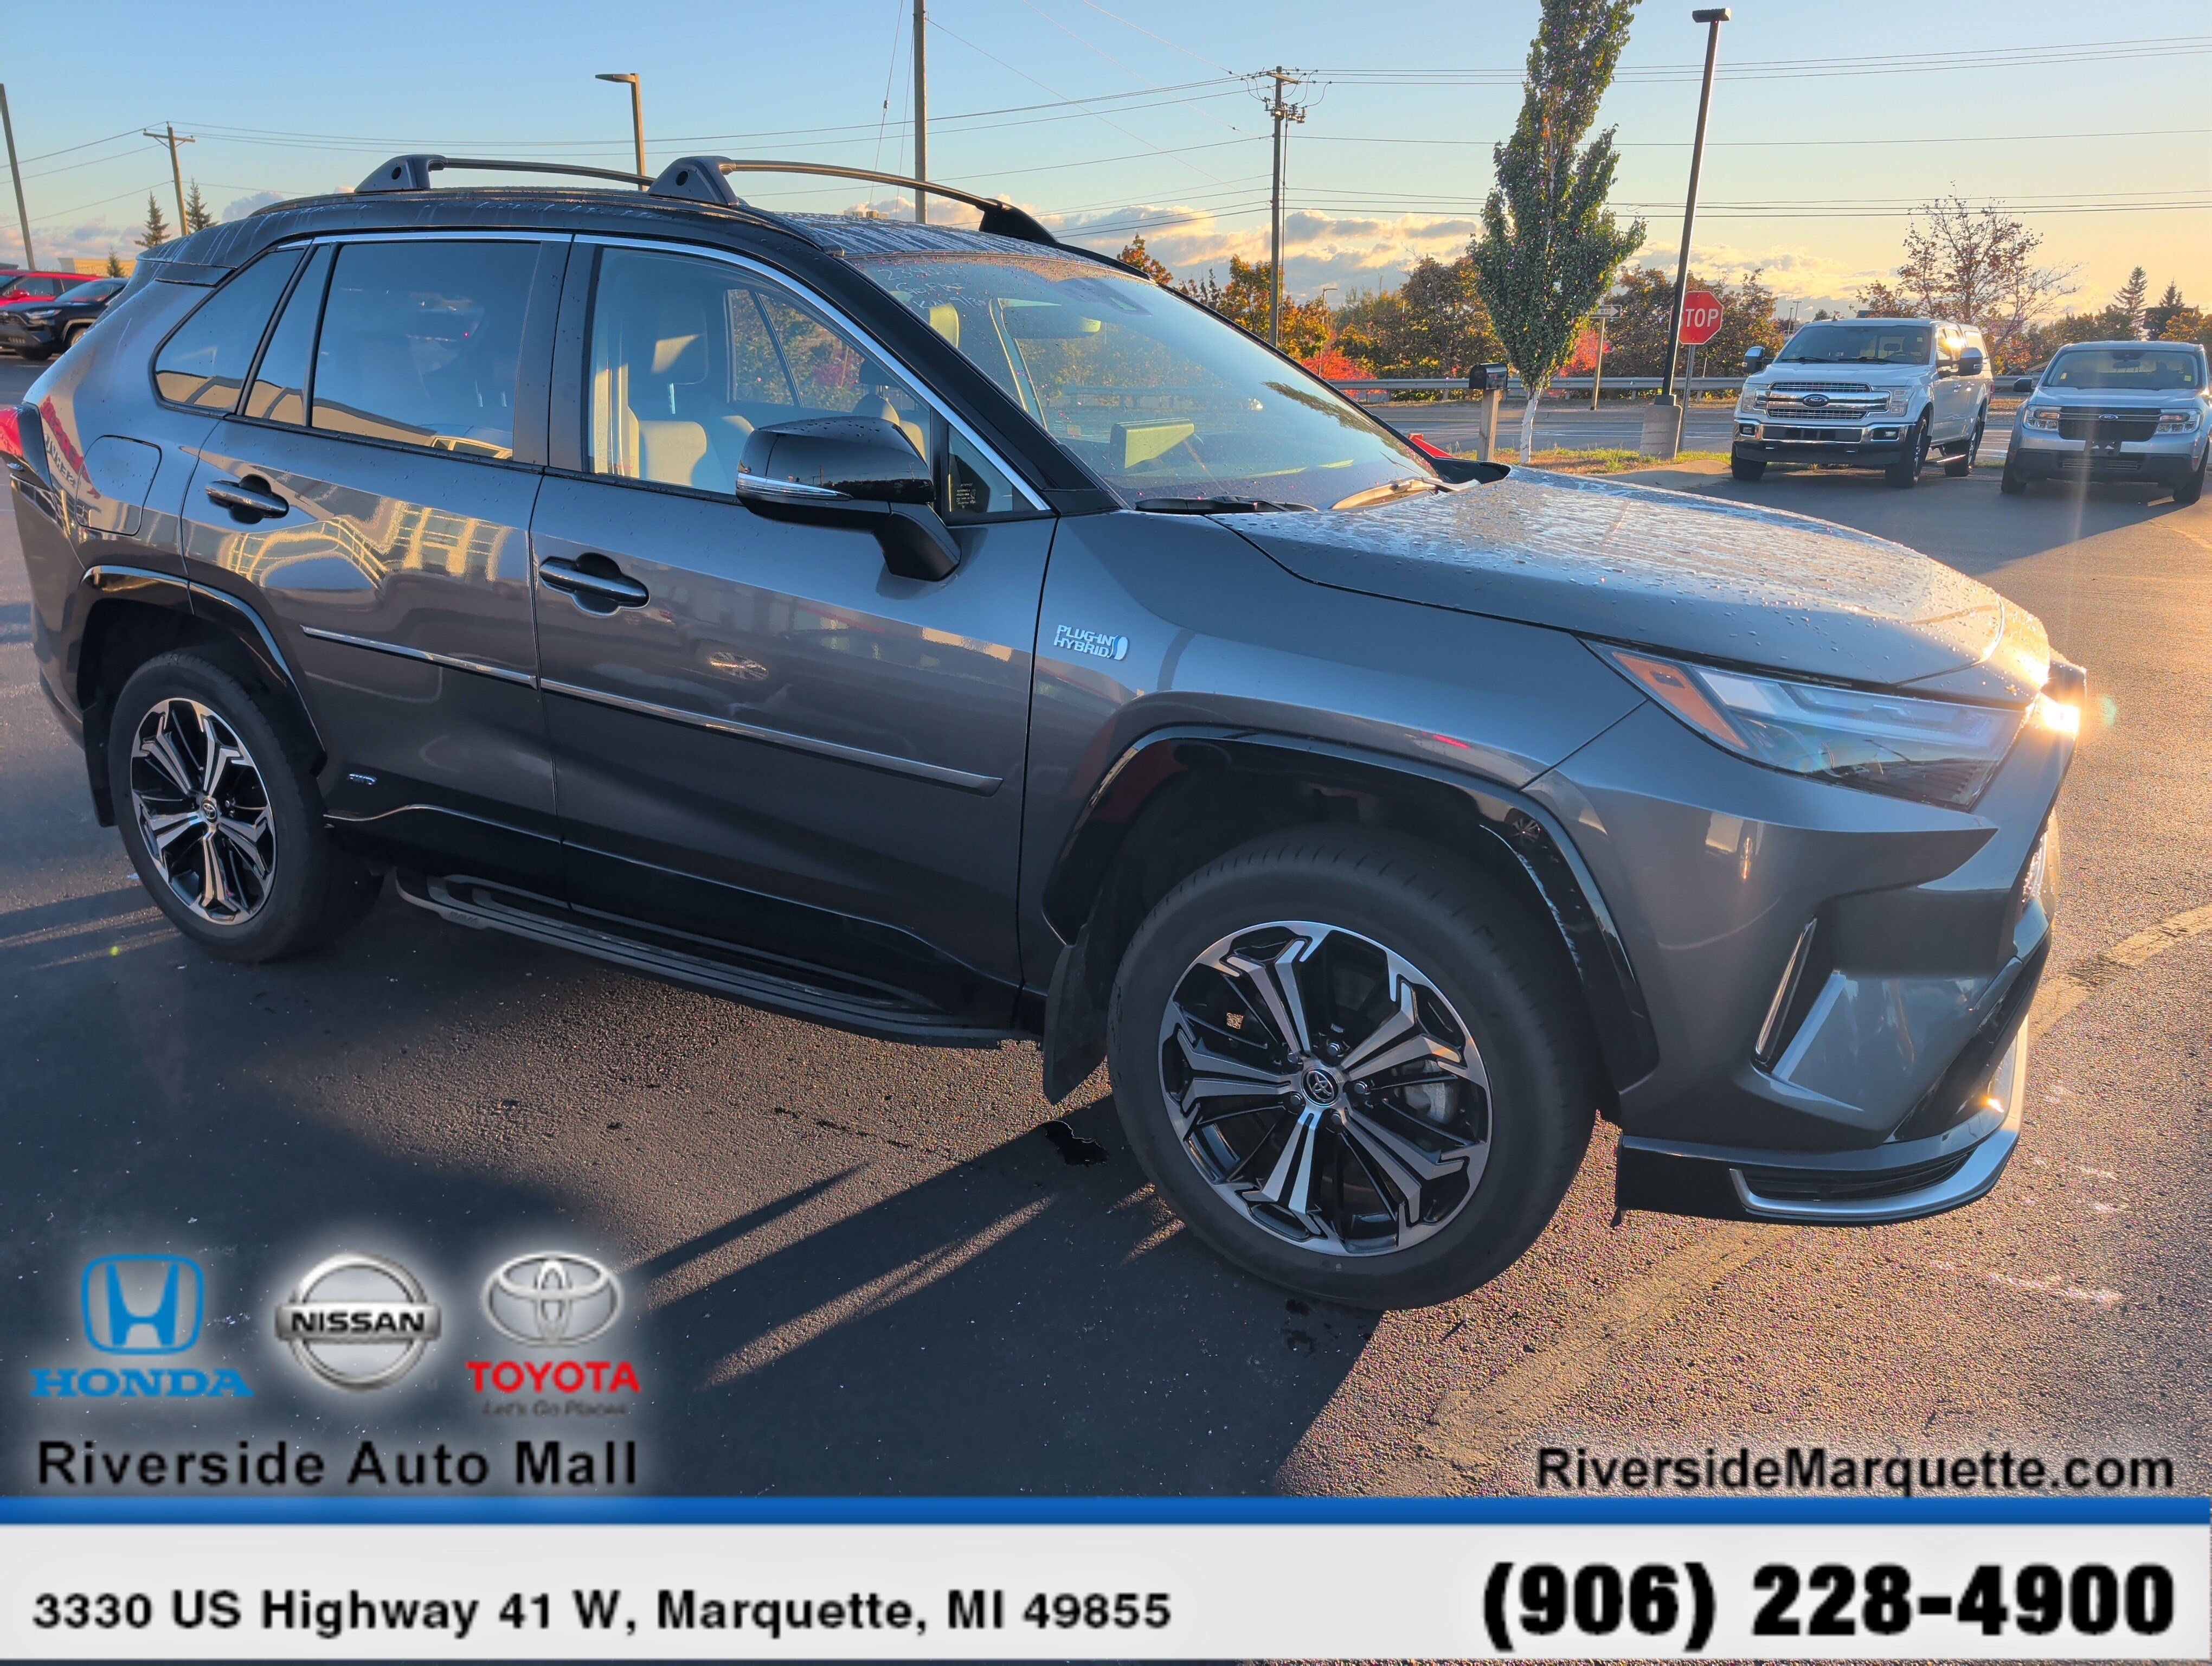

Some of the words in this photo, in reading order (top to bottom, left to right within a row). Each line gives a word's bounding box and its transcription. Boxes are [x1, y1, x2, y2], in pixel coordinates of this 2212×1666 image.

[1681, 308, 1719, 328] TOP
[1057, 625, 1115, 646] PLUG-IN
[1053, 635, 1110, 658] HYBRID
